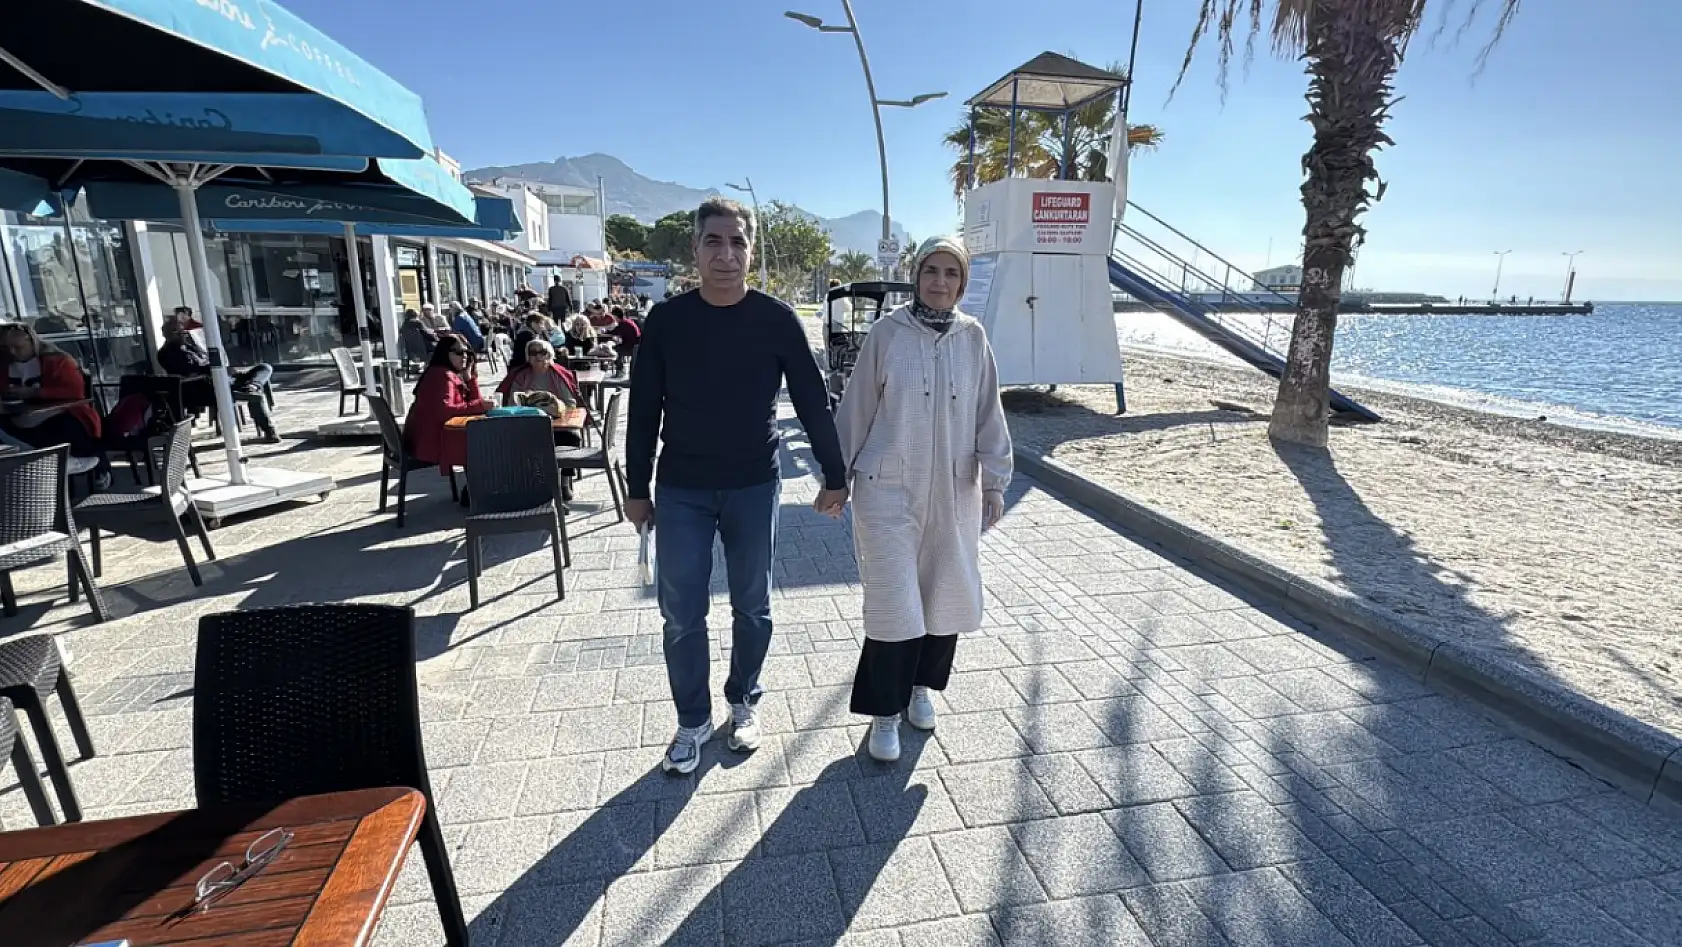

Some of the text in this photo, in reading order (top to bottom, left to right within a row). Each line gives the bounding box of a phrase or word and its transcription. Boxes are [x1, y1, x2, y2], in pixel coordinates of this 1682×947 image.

[225, 194, 306, 209] Caribou
[1040, 196, 1082, 208] LIFEGUARD
[1034, 209, 1088, 221] CANKURTARAN
